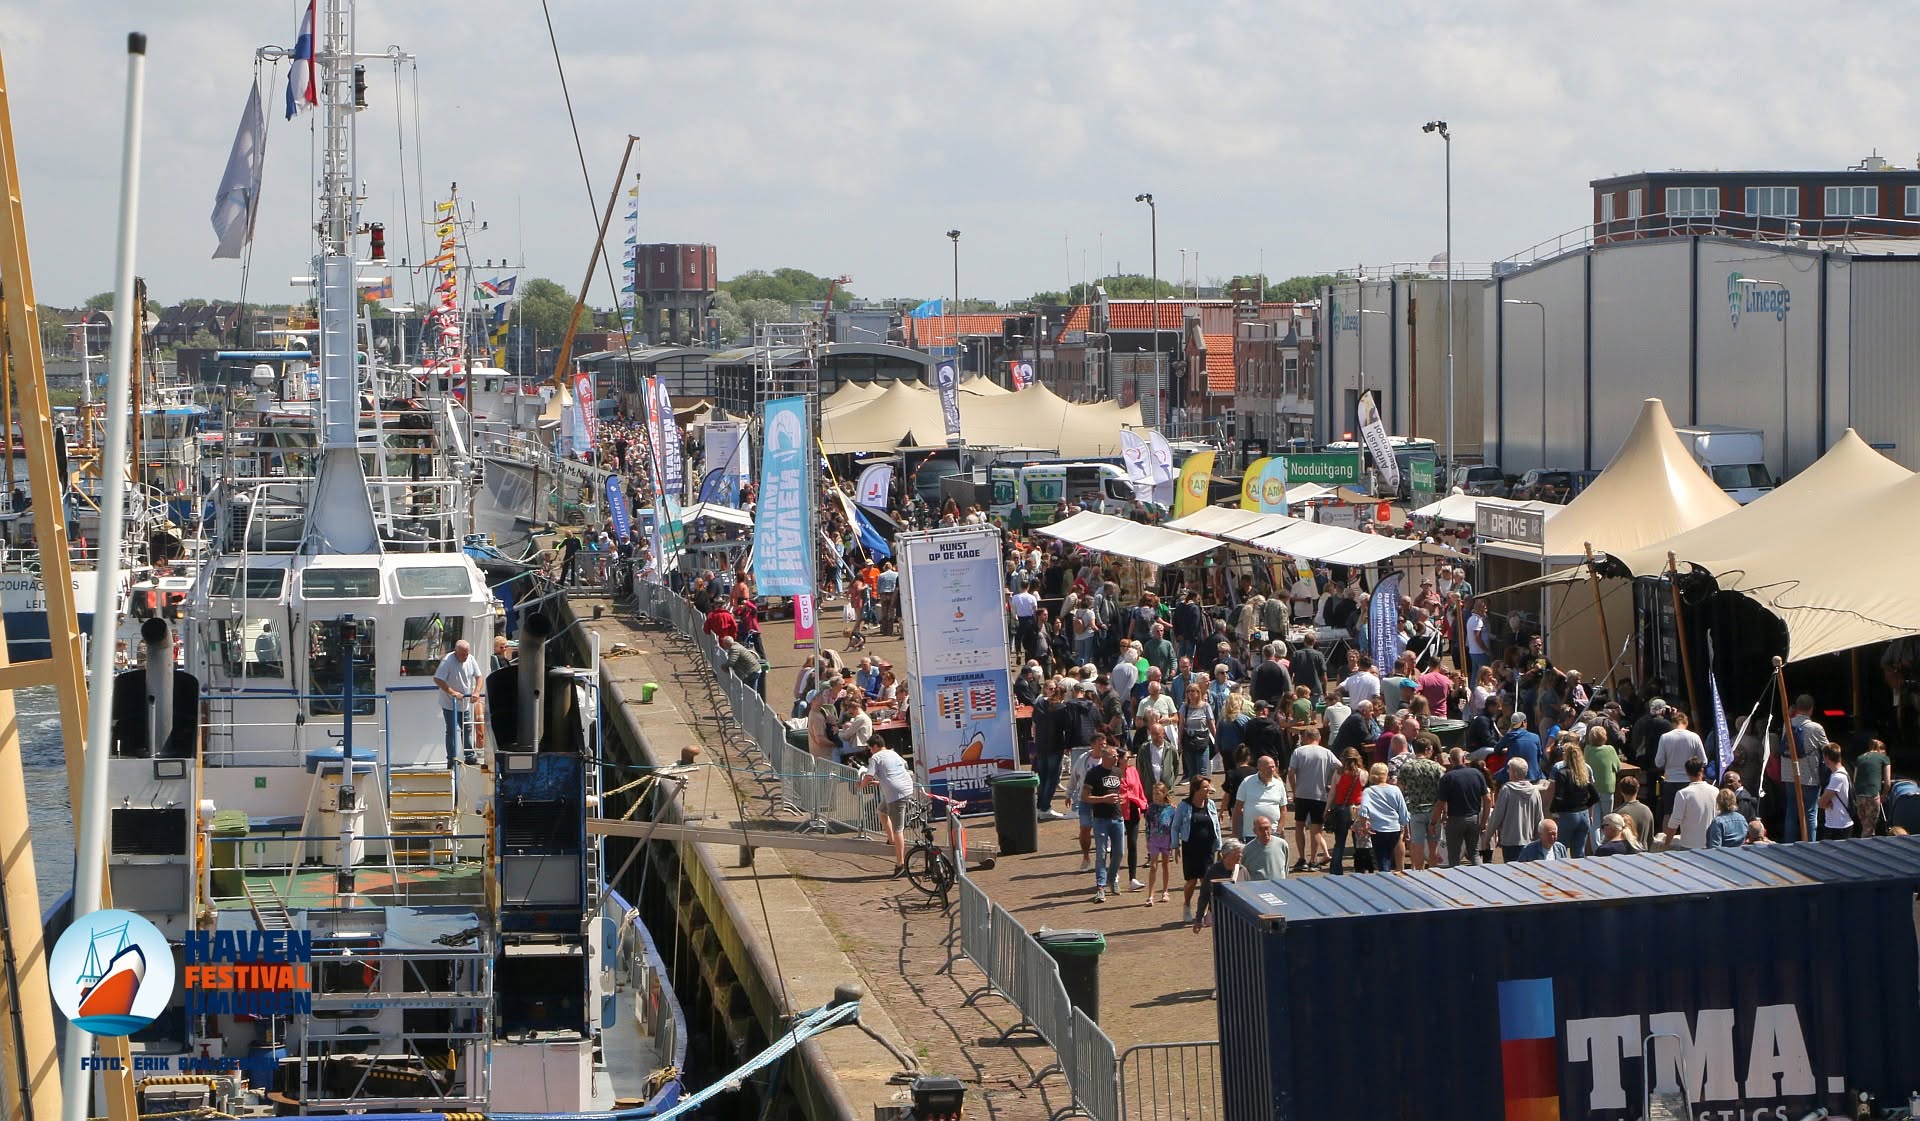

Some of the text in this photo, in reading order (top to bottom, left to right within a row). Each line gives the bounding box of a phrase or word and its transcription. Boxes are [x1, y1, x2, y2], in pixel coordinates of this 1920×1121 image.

[1745, 284, 1790, 321] Lineage
[1342, 310, 1360, 337] Lineag
[664, 418, 674, 480] HAVEN
[1367, 431, 1387, 469] Airbrush
[1291, 463, 1353, 478] Nooduitgang
[1491, 513, 1527, 537] DRINKS
[929, 549, 981, 561] OP DE KADE
[939, 541, 968, 552] KUNST
[944, 672, 985, 683] PROGRAMMA
[945, 762, 998, 780] HAVEN
